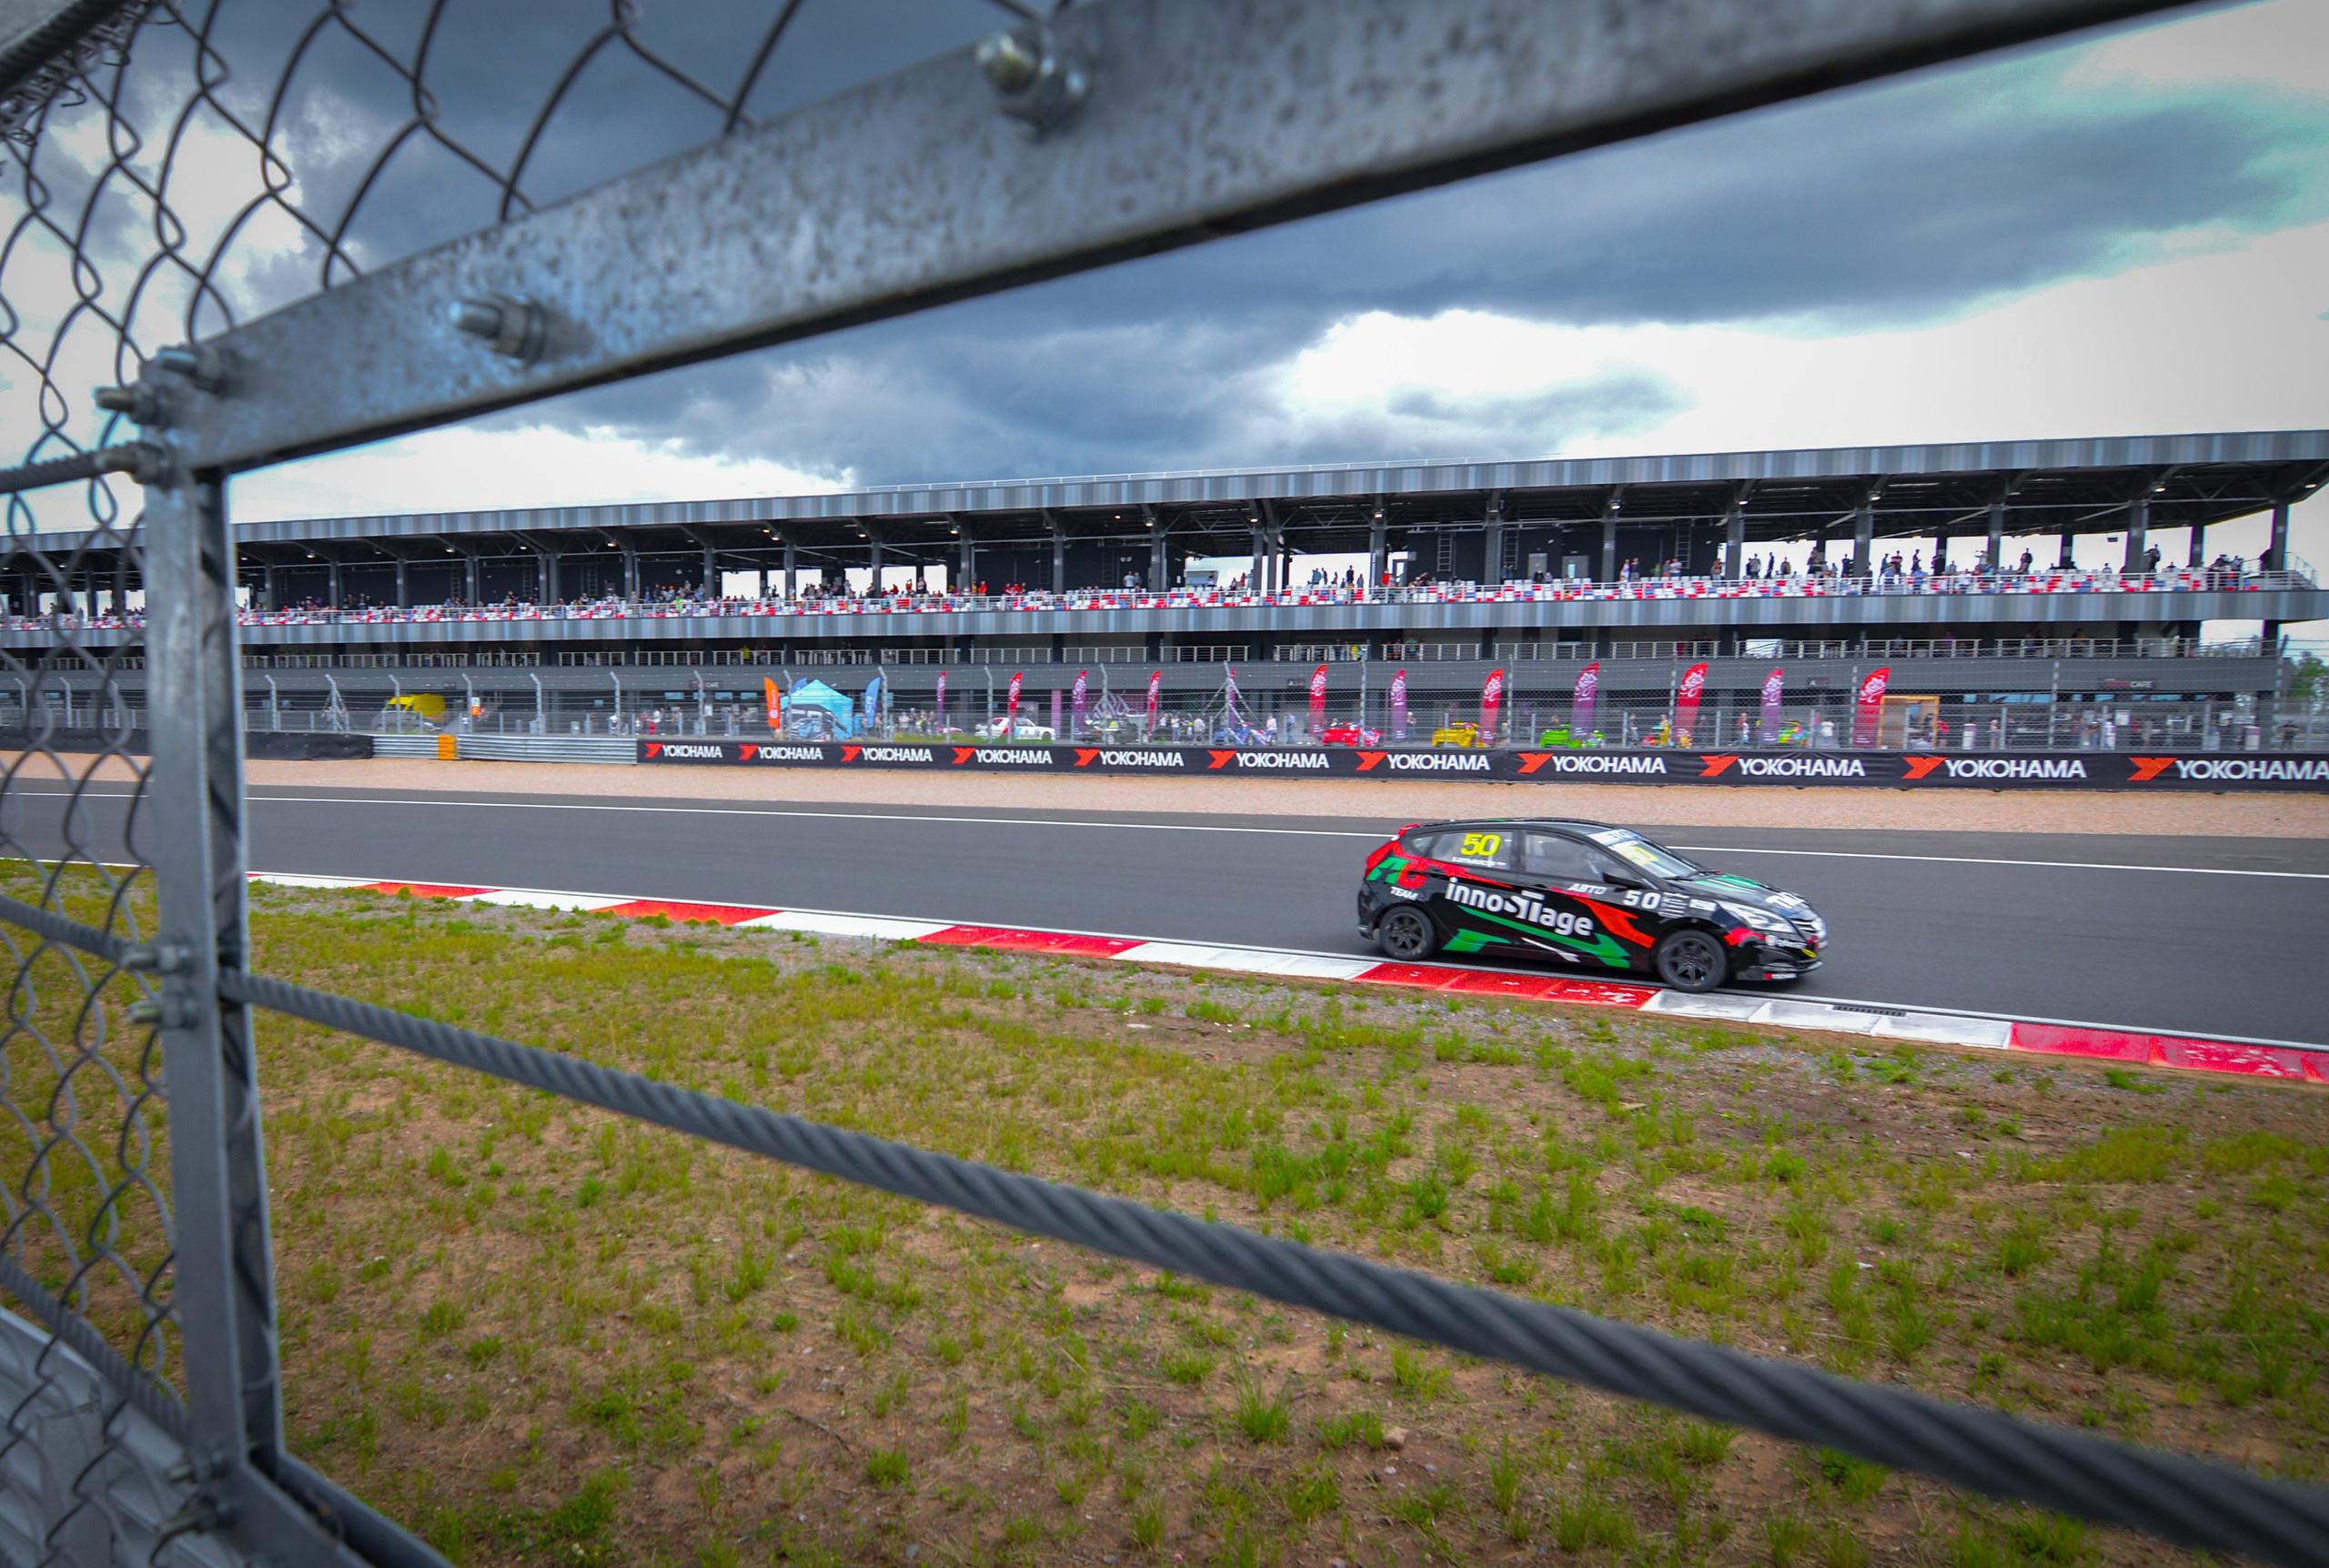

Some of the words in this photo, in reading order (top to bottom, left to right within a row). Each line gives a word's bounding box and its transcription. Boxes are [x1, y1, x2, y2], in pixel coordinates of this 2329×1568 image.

[662, 745, 723, 759] YOKOHAMA
[757, 746, 824, 760] YOKOHAMA
[862, 747, 933, 762] YOKOHAMA
[974, 749, 1054, 765] YOKOHAMA
[1099, 750, 1185, 767] YOKOHAMA
[1236, 752, 1330, 769] YOKOHAMA
[1386, 753, 1491, 770] YOKOHAMA
[1551, 755, 1667, 774] YOKOHAMA
[1737, 758, 1866, 777] YOKOHAMA
[1944, 759, 2087, 779] YOKOHAMA
[2174, 759, 2329, 779] YOKOHAMA
[1460, 832, 1501, 857] 50
[1390, 886, 1419, 901] TEAM
[1622, 890, 1662, 910] 50
